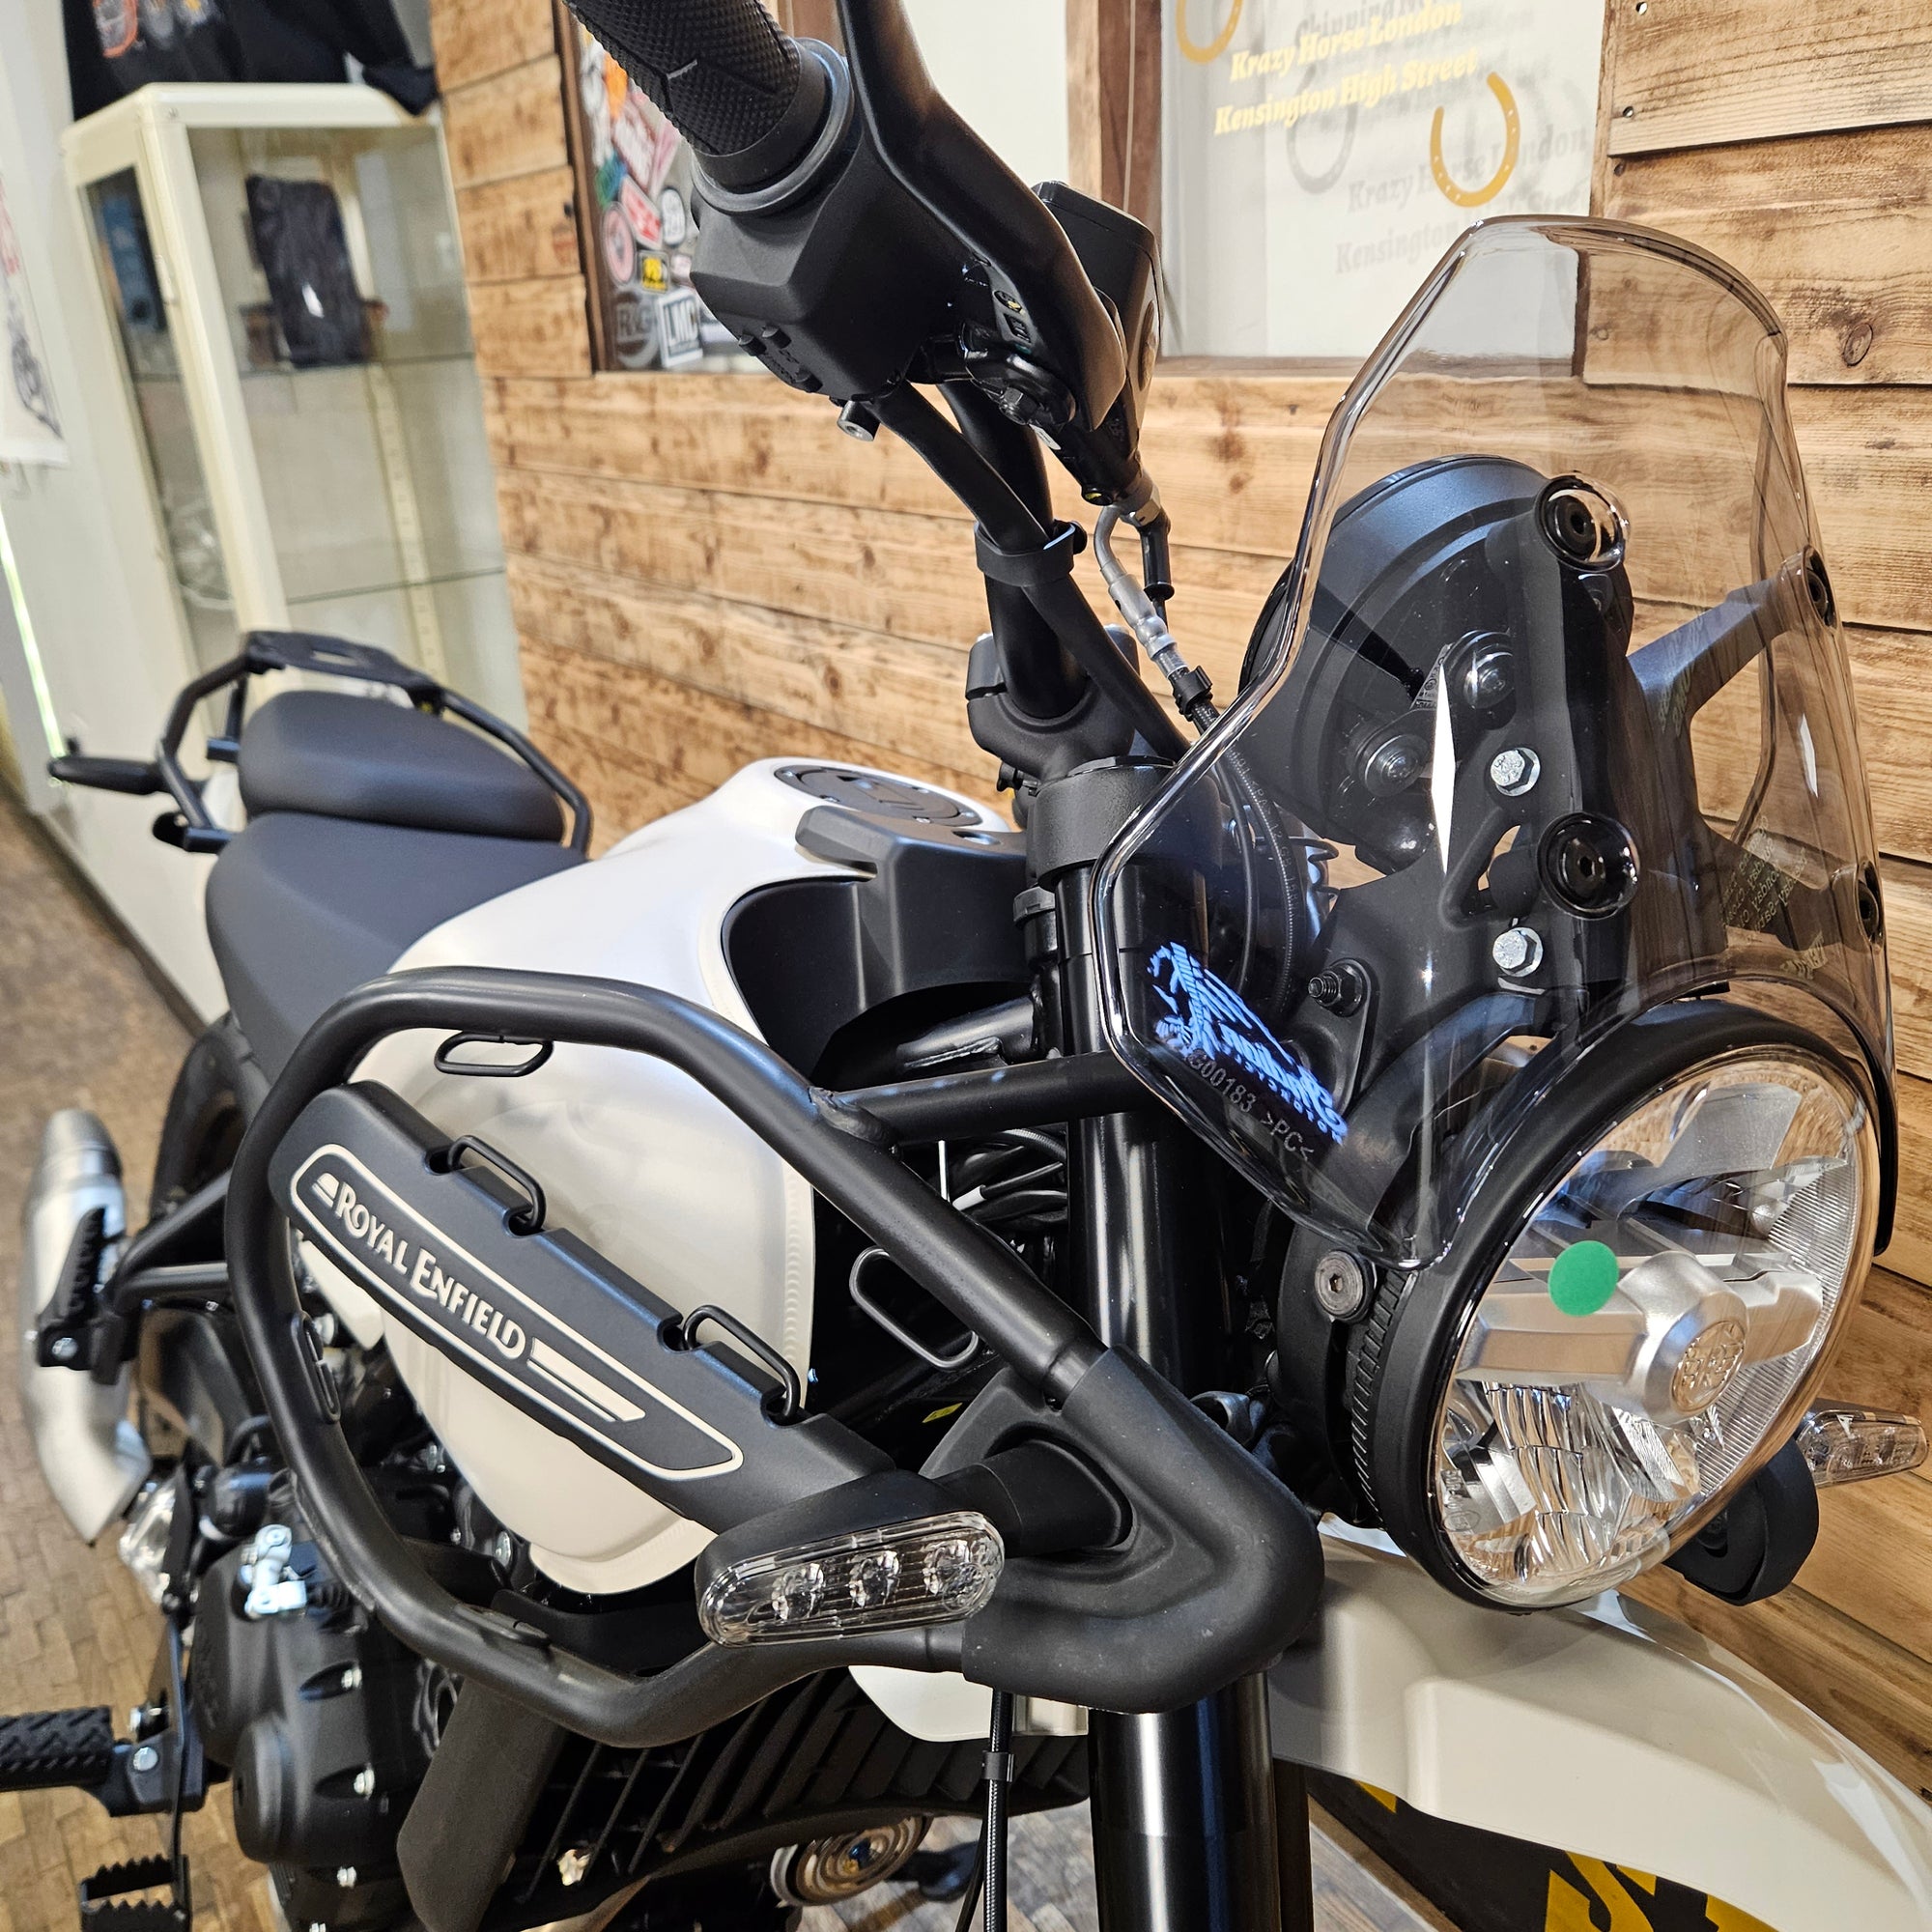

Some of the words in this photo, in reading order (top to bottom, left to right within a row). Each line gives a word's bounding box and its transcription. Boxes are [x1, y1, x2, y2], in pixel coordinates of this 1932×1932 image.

[1230, 45, 1296, 83] Krazy
[1297, 26, 1367, 67] Horse
[1367, 1, 1463, 47] London
[1213, 84, 1337, 136] Kensington
[1340, 63, 1398, 108] High
[1400, 46, 1480, 92] Street
[1347, 174, 1415, 213] Krazy
[1335, 220, 1460, 274] Kensington
[334, 1180, 409, 1275] ROYAL
[410, 1247, 526, 1360] ENFIELD
